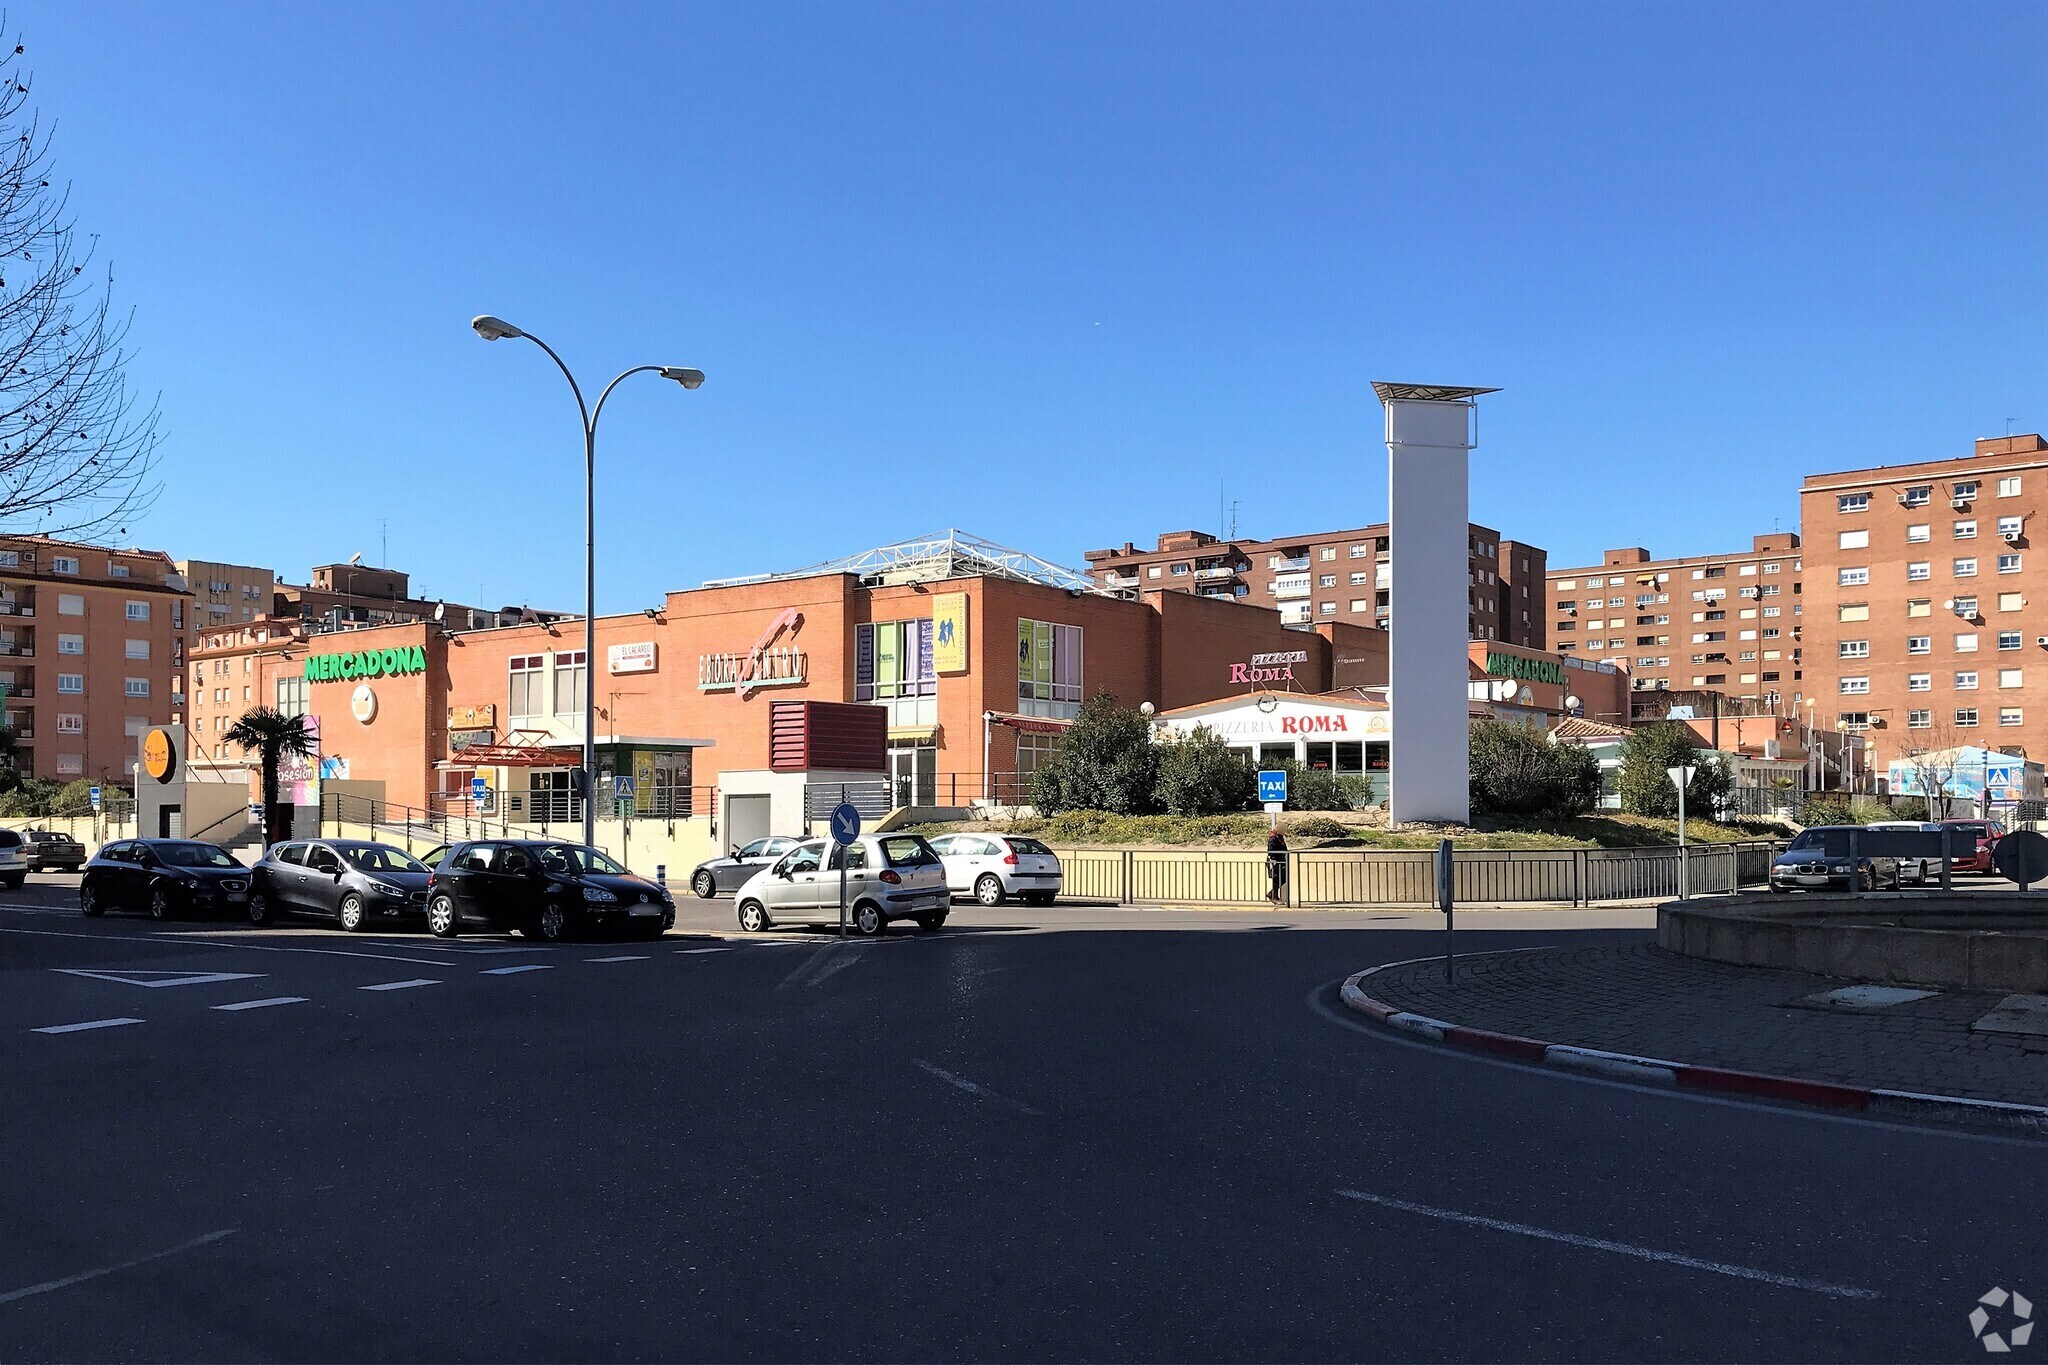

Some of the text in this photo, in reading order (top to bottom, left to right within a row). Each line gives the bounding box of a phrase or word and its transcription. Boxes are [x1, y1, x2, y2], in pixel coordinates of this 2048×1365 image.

[622, 646, 628, 655] EL
[1250, 651, 1308, 666] PIZZERIA
[304, 645, 427, 681] MERCADONA
[699, 652, 737, 684] EBORA
[1486, 652, 1564, 685] MERCADONA
[1229, 662, 1294, 684] ROMA
[1213, 721, 1274, 734] PIZZERIA
[1282, 715, 1348, 734] ROMA
[1260, 781, 1285, 791] TAXI
